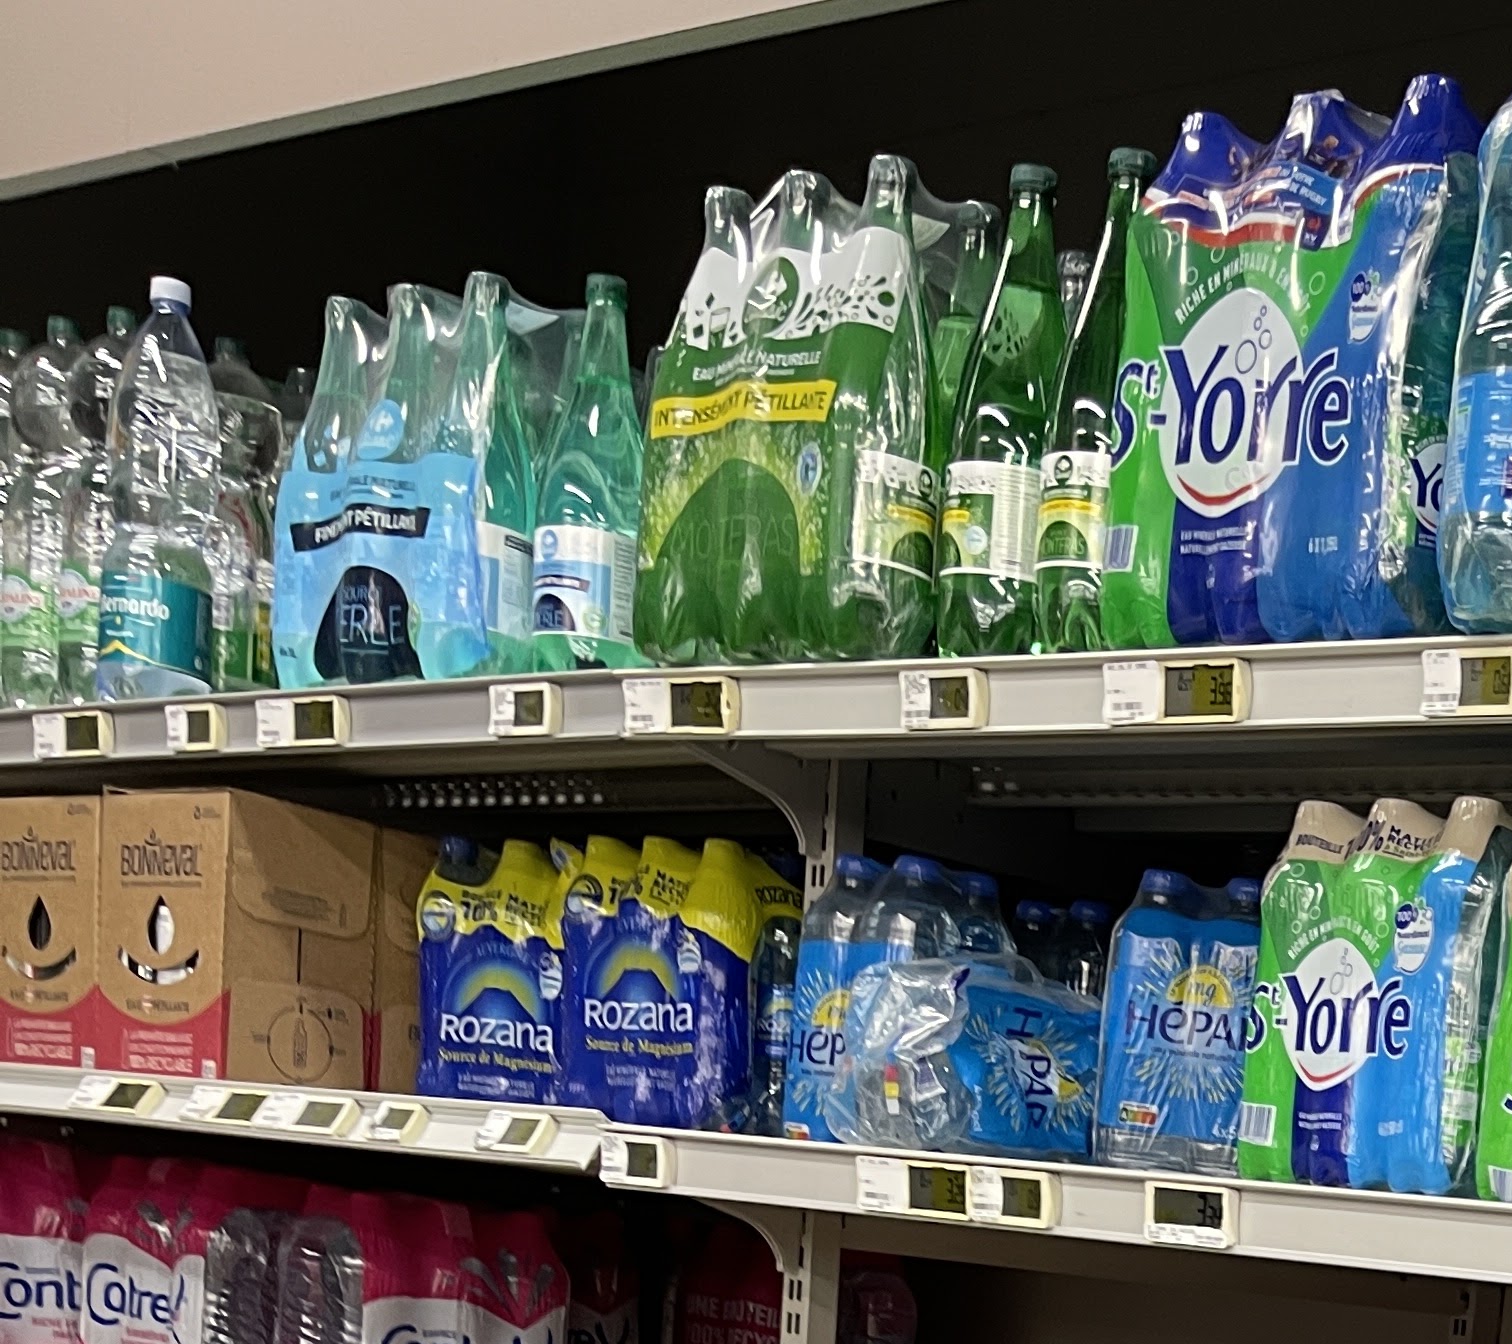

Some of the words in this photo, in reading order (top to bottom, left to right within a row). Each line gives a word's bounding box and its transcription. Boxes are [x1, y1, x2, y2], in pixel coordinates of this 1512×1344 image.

[1174, 281, 1206, 326] RICHE
[1206, 267, 1222, 295] EN
[339, 603, 402, 647] ERLE
